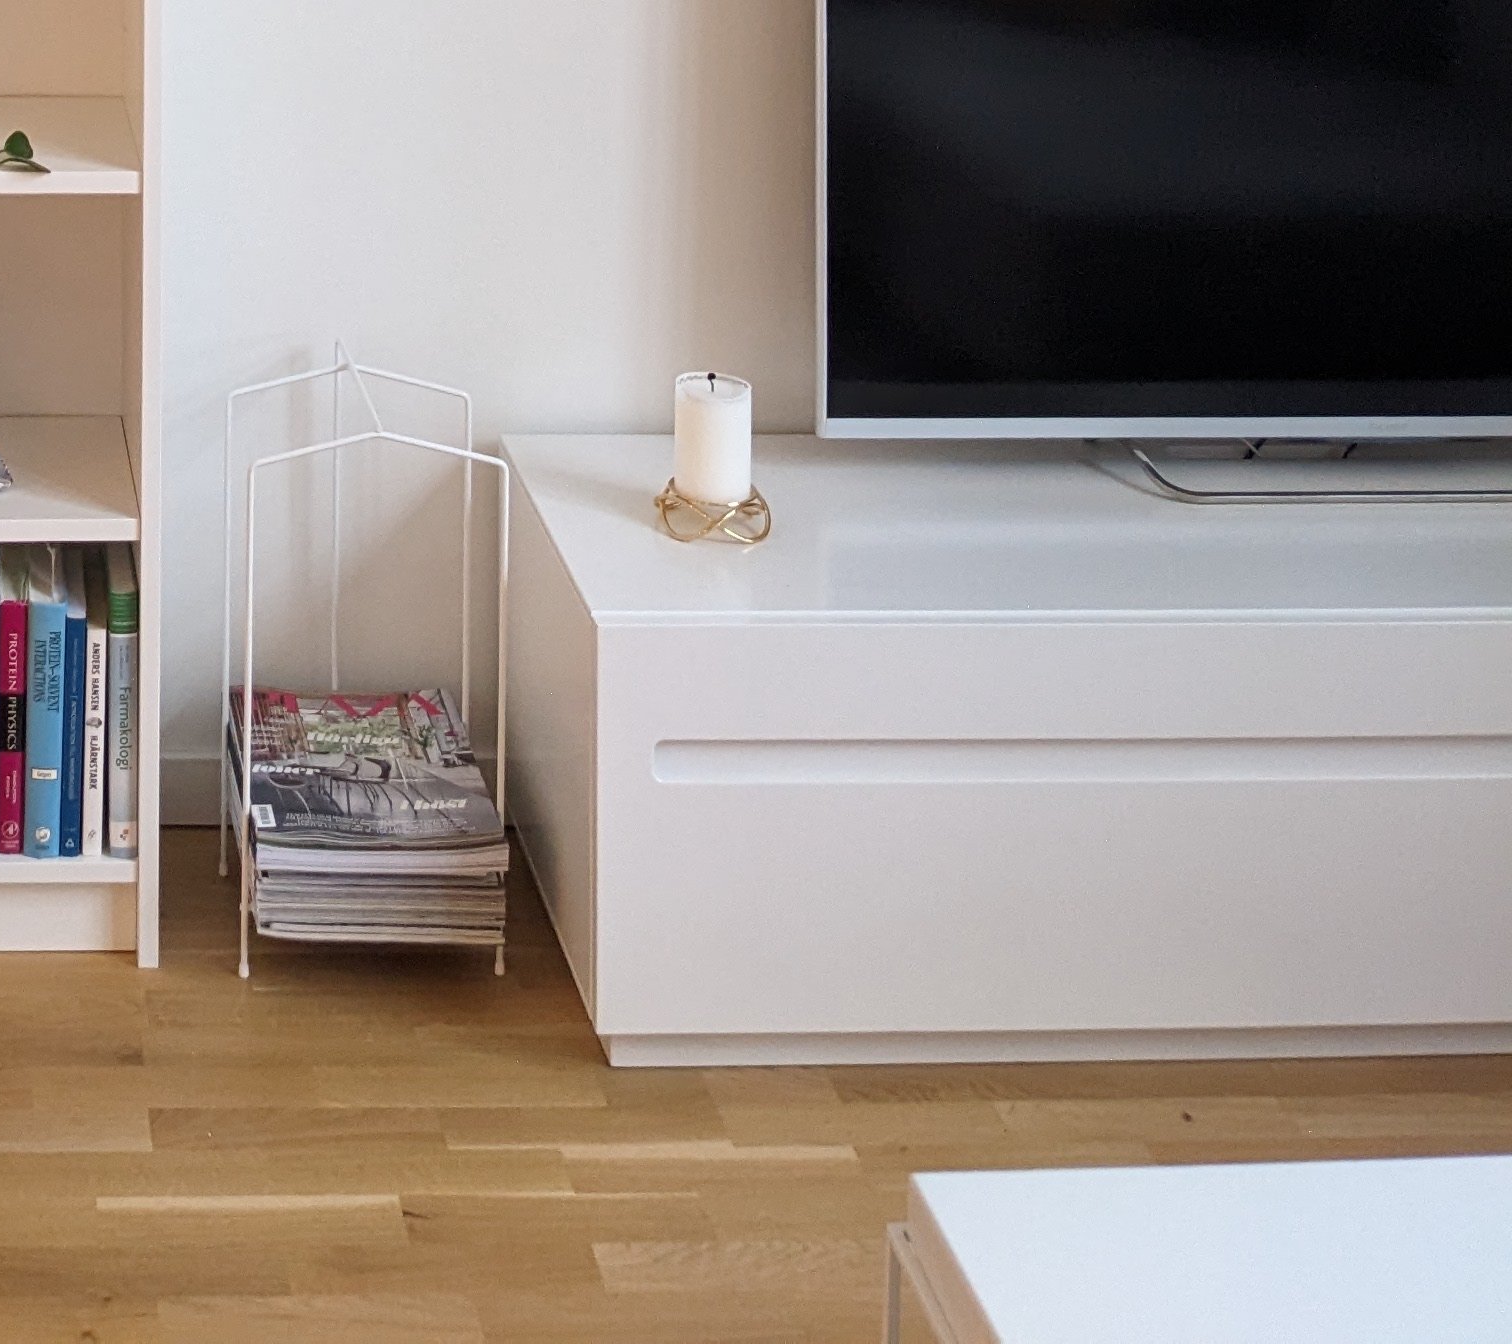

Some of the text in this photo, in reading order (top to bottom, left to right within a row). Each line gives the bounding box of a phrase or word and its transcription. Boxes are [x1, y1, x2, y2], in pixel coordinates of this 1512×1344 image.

[7, 632, 19, 751] PROTEIN PHYSICS
[88, 643, 101, 790] ANDERS HANSEN HJÄRNSTARK
[115, 686, 133, 771] Farmakologi
